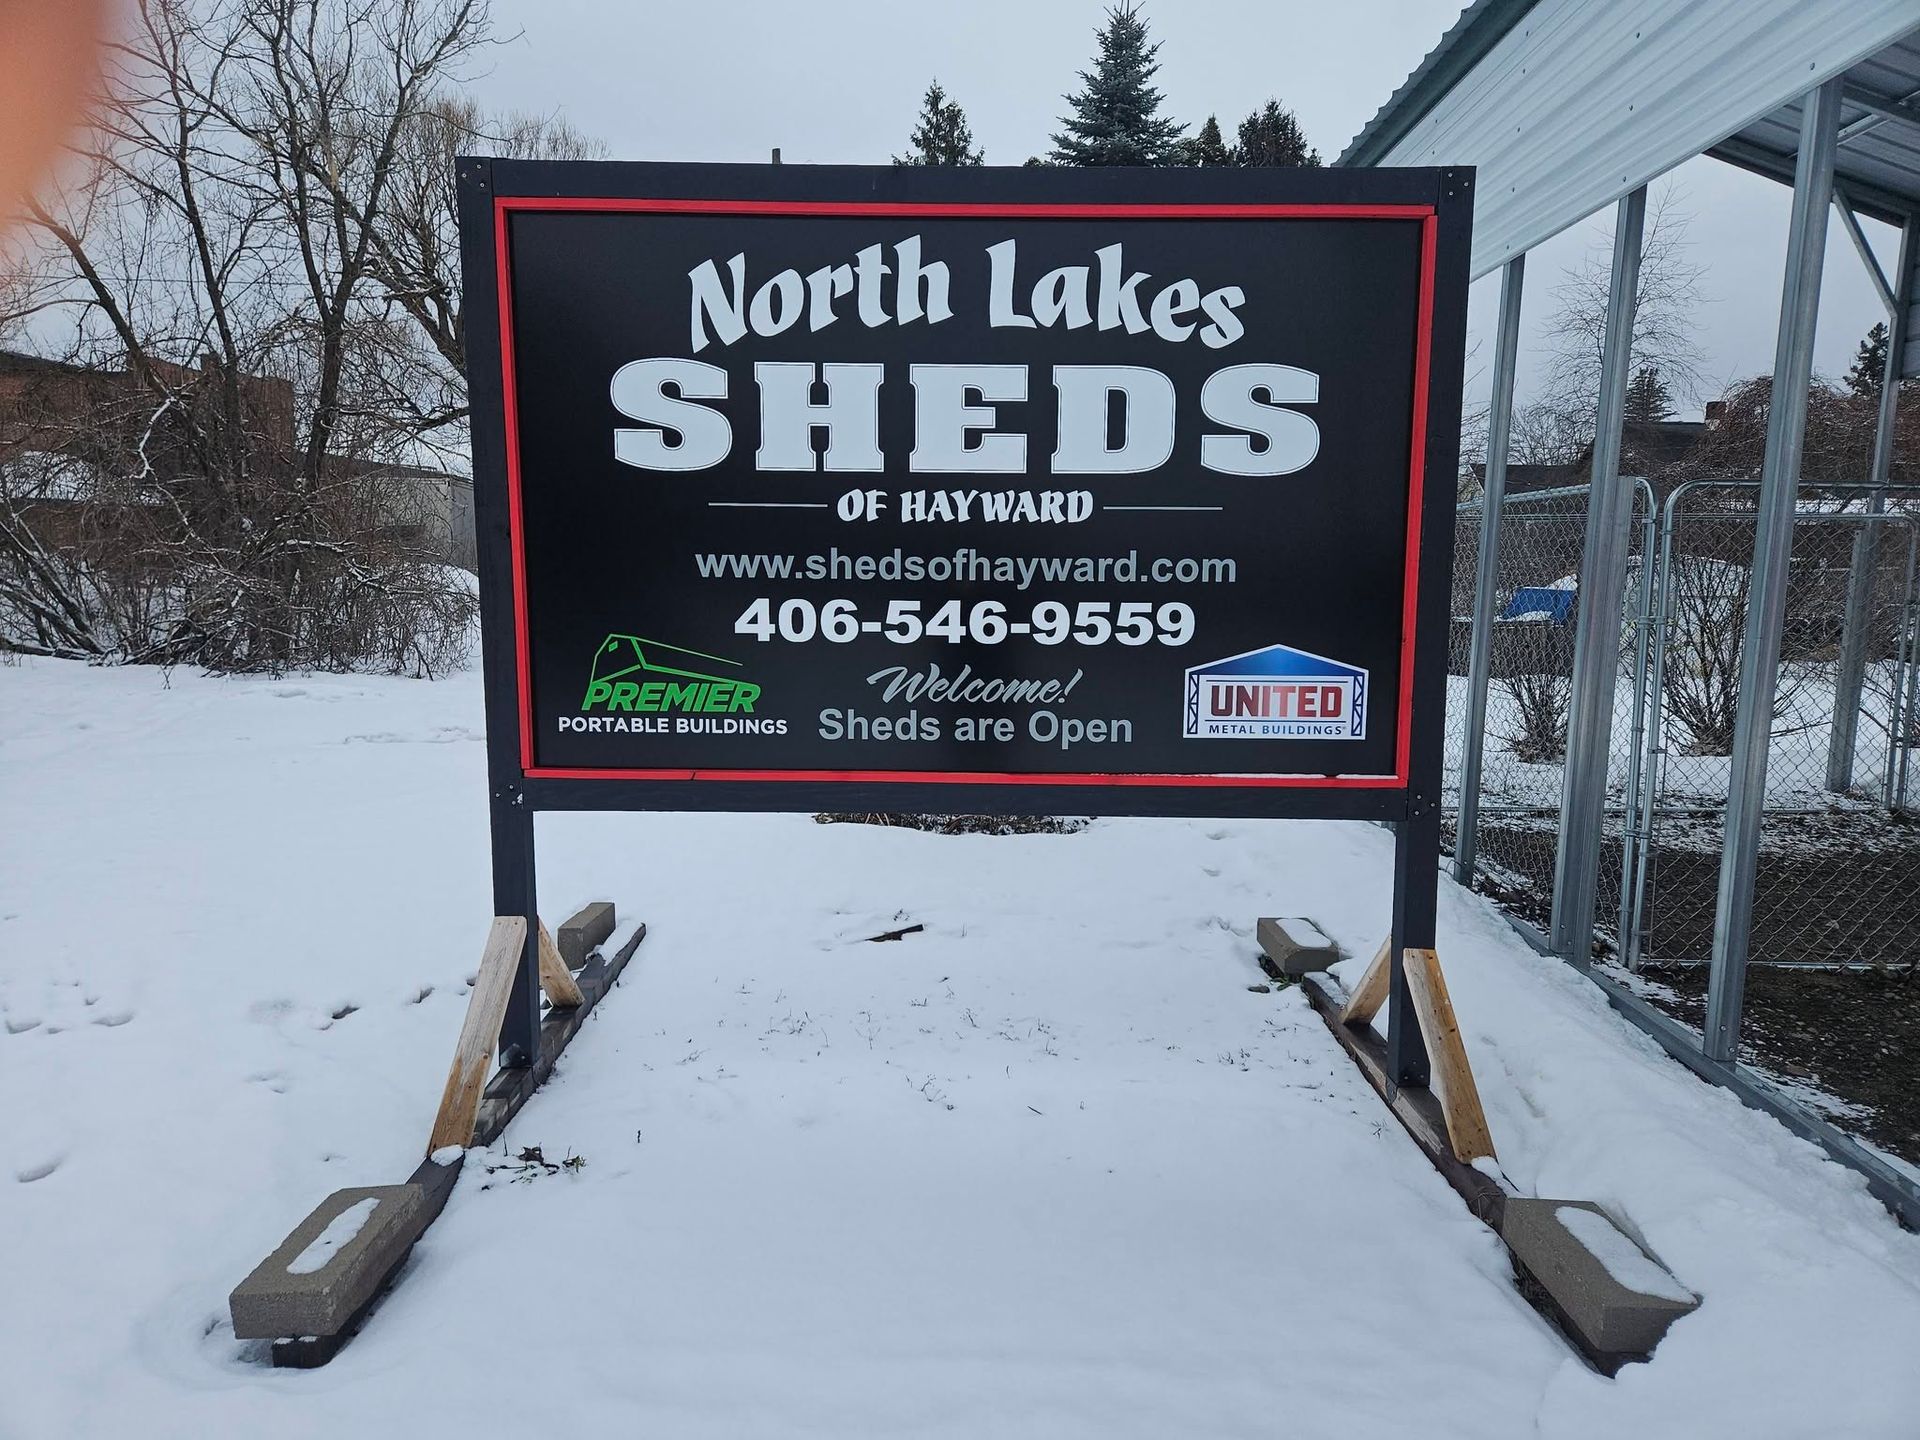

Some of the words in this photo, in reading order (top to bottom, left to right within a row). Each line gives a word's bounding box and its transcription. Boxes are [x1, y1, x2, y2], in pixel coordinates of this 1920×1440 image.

[688, 235, 954, 354] North
[985, 239, 1246, 350] Lakes
[609, 357, 1321, 476] SHEDS
[836, 488, 887, 523] OF
[899, 489, 1095, 525] HAYWARD
[696, 547, 1237, 590] www.shedsofhayward.com
[734, 598, 1195, 647] 406-546-9559
[581, 678, 761, 713] PREMIER
[866, 663, 1084, 704] Welcome!
[1210, 685, 1343, 718] UNITED
[558, 716, 669, 733] PORTABLE
[676, 718, 788, 735] BUILDINGS
[817, 708, 941, 742] Sheds
[954, 717, 1015, 743] are
[1030, 710, 1134, 749] Open
[1208, 724, 1256, 735] METAL
